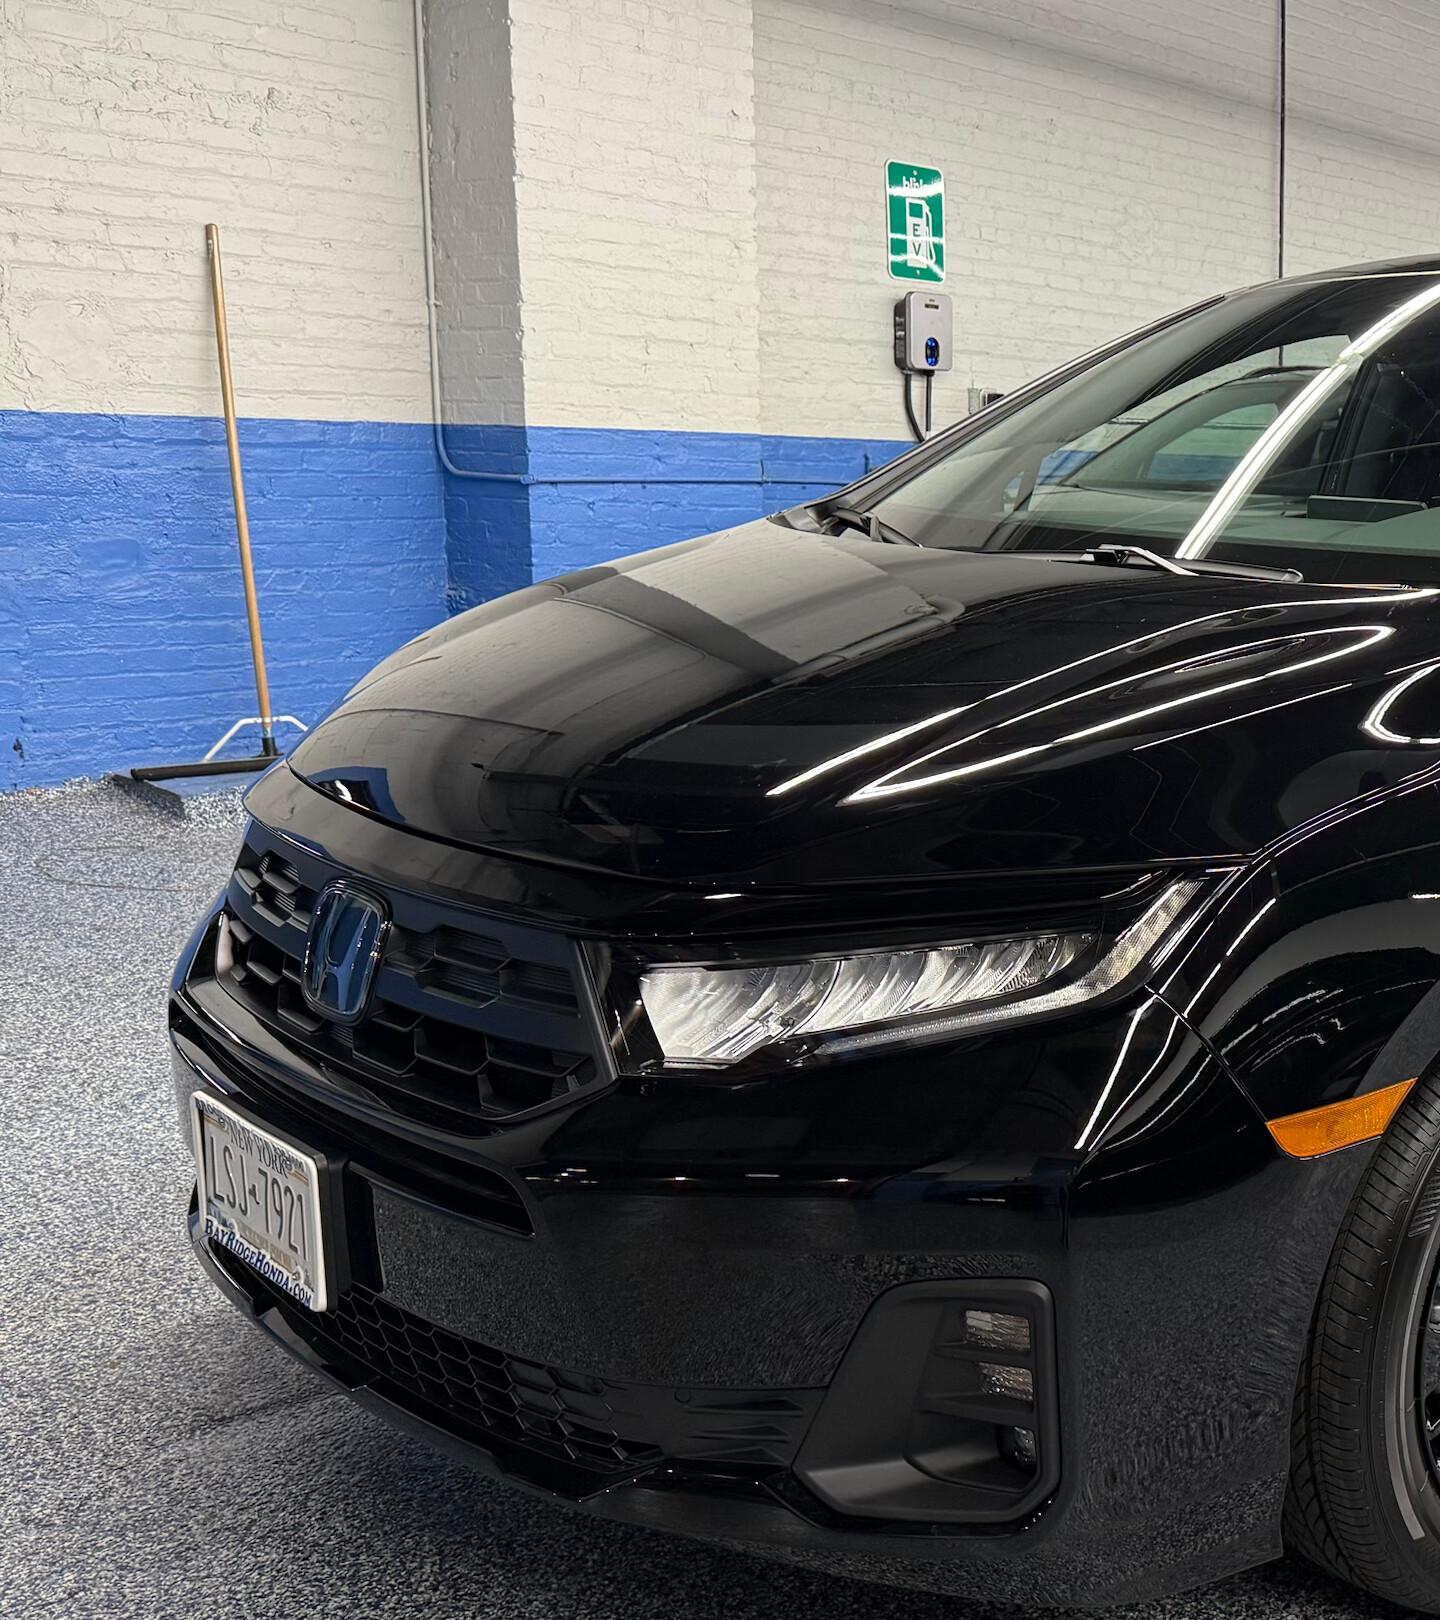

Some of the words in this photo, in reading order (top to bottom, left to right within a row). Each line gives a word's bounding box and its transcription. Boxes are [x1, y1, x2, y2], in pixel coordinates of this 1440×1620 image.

[230, 1118, 256, 1155] NEW
[252, 1130, 288, 1180] YORK
[210, 1136, 248, 1216] LSJ
[258, 1168, 309, 1262] 7921
